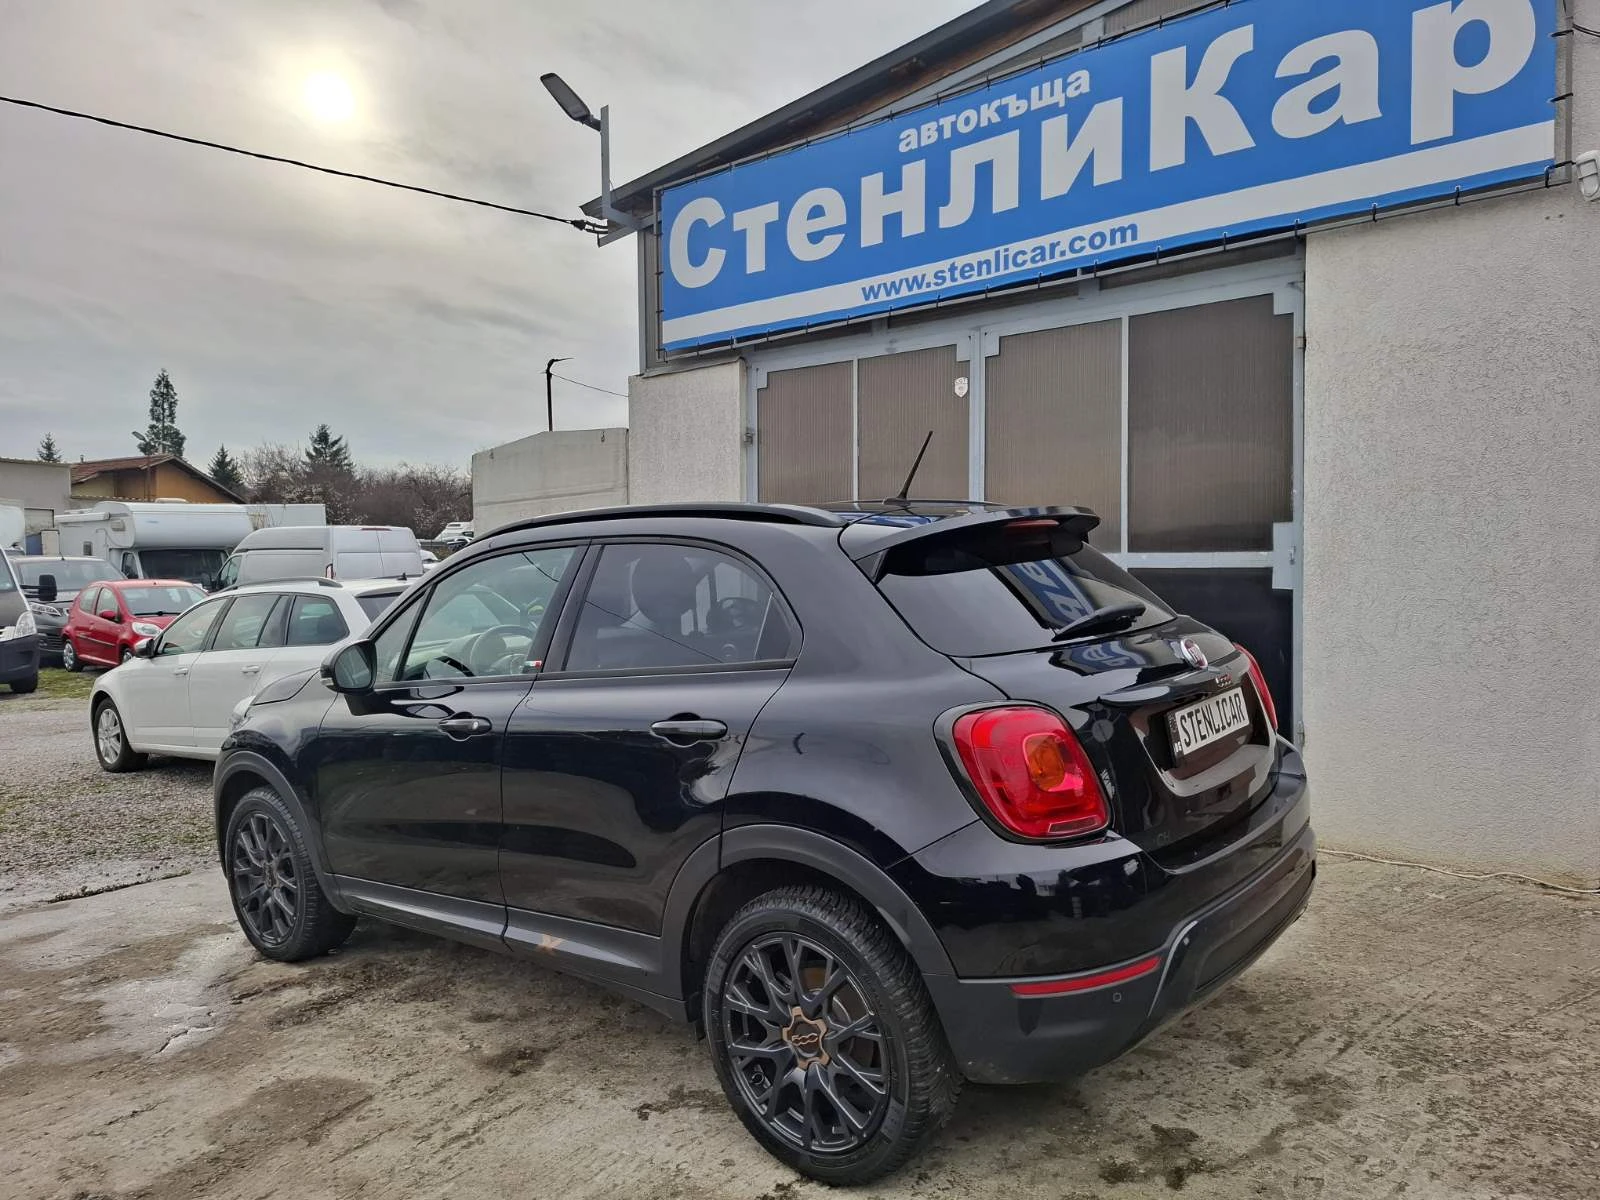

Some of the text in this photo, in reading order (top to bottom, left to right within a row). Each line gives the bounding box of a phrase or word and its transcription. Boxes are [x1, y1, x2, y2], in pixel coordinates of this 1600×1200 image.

[669, 0, 1537, 289] СтенлиКар
[898, 69, 1091, 154] автокъща
[861, 223, 1139, 302] www.stenlicar.com
[1180, 692, 1246, 748] STENLICAR
